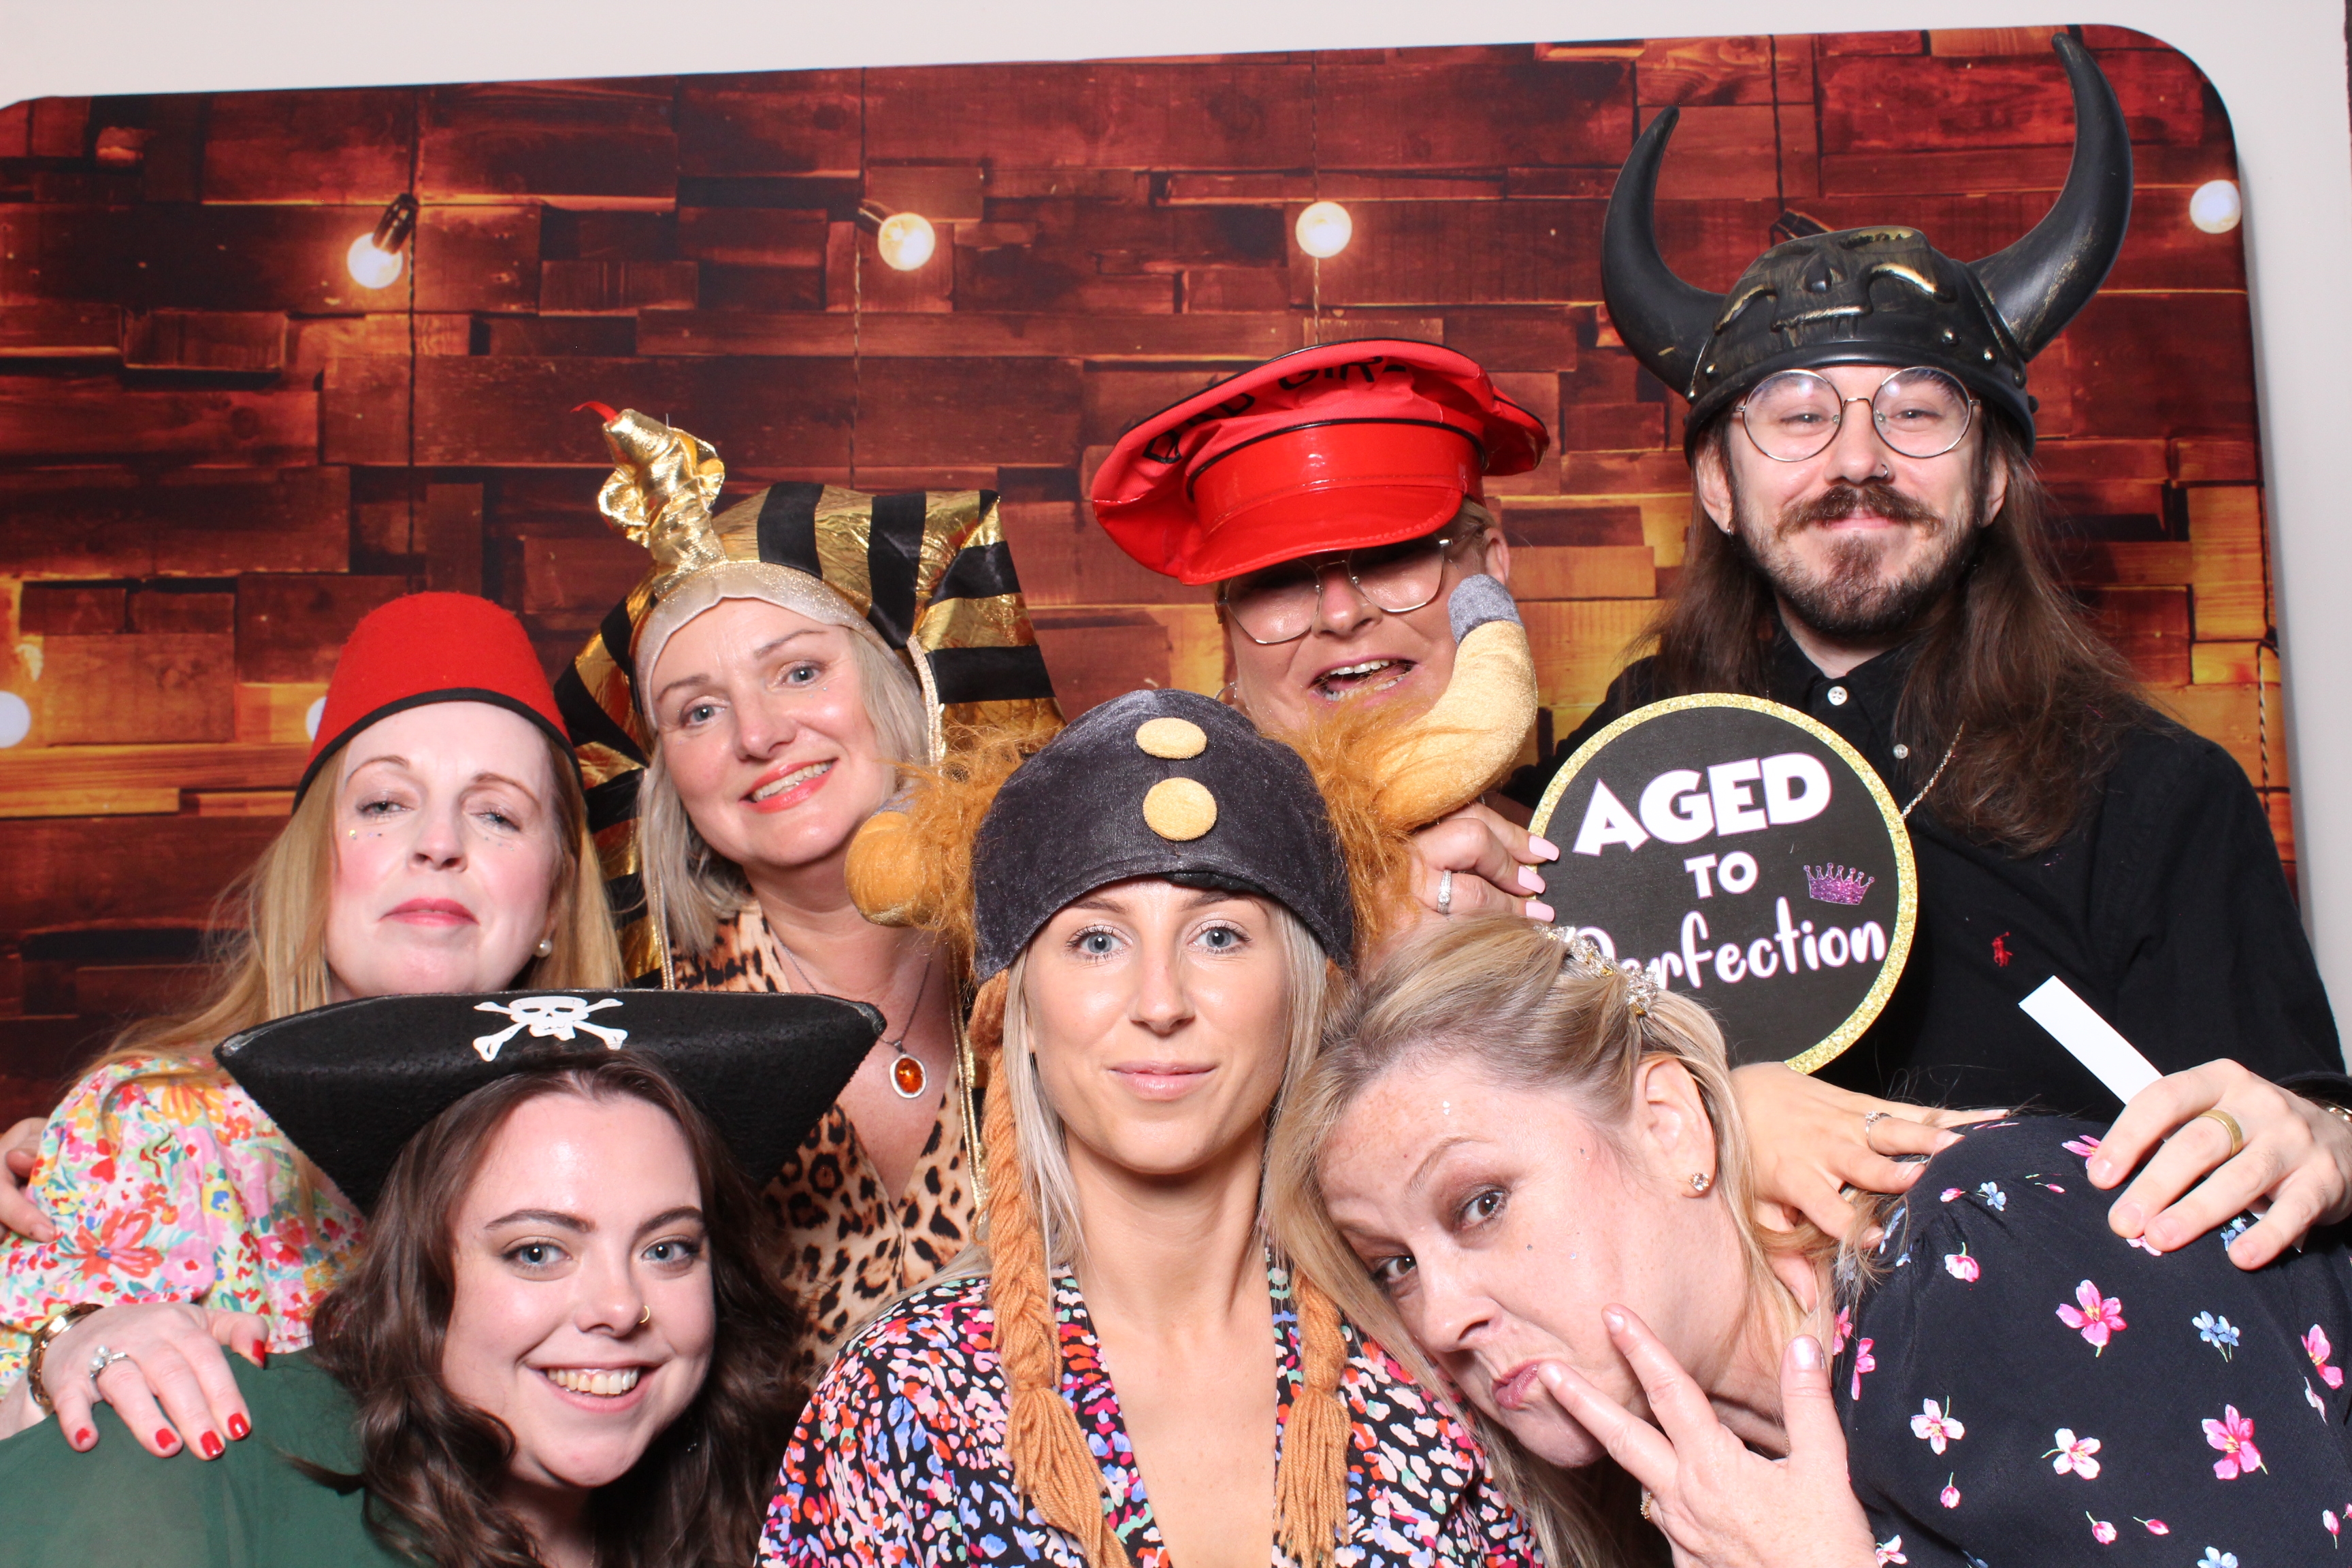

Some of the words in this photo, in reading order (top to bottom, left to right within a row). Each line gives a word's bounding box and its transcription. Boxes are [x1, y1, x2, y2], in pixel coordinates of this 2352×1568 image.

[1278, 355, 1407, 391] GIR
[1572, 752, 1831, 856] AGED
[1684, 851, 1758, 898] TO
